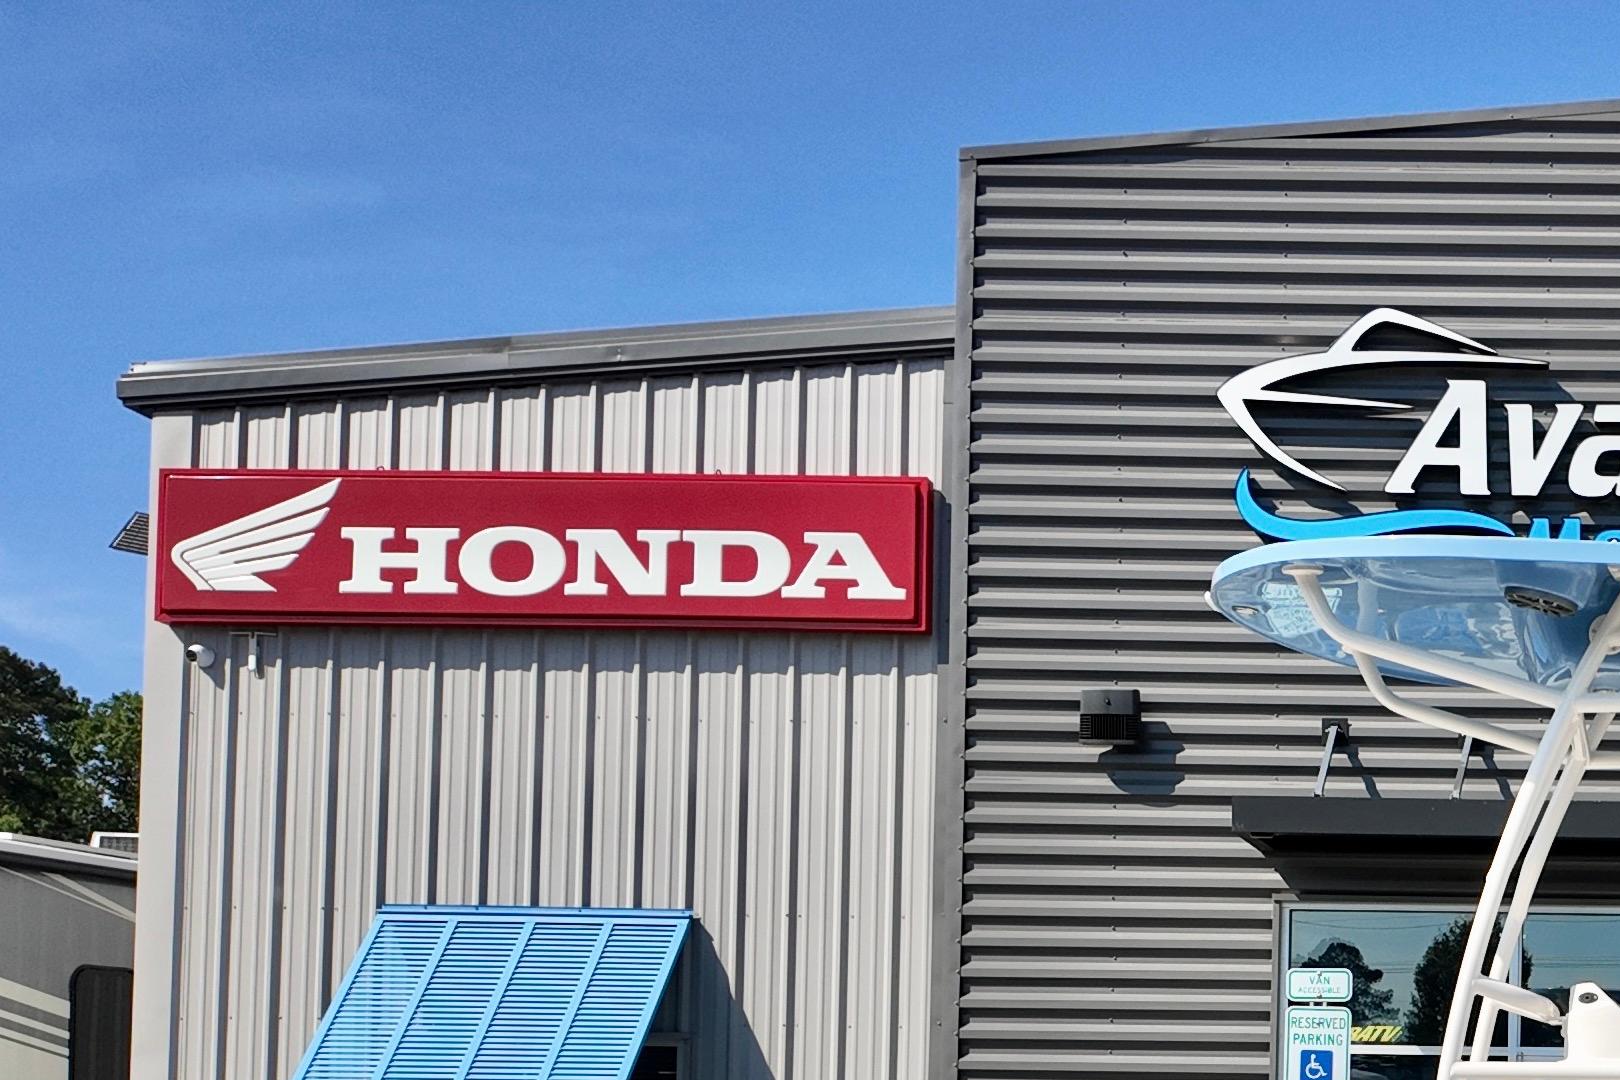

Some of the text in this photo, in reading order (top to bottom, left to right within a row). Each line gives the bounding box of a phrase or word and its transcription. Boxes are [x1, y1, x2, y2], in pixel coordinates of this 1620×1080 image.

[339, 525, 907, 600] HONDA
[1308, 975, 1331, 985] VAN
[1290, 1016, 1347, 1030] RESERVED
[1293, 1033, 1344, 1046] PARKING
